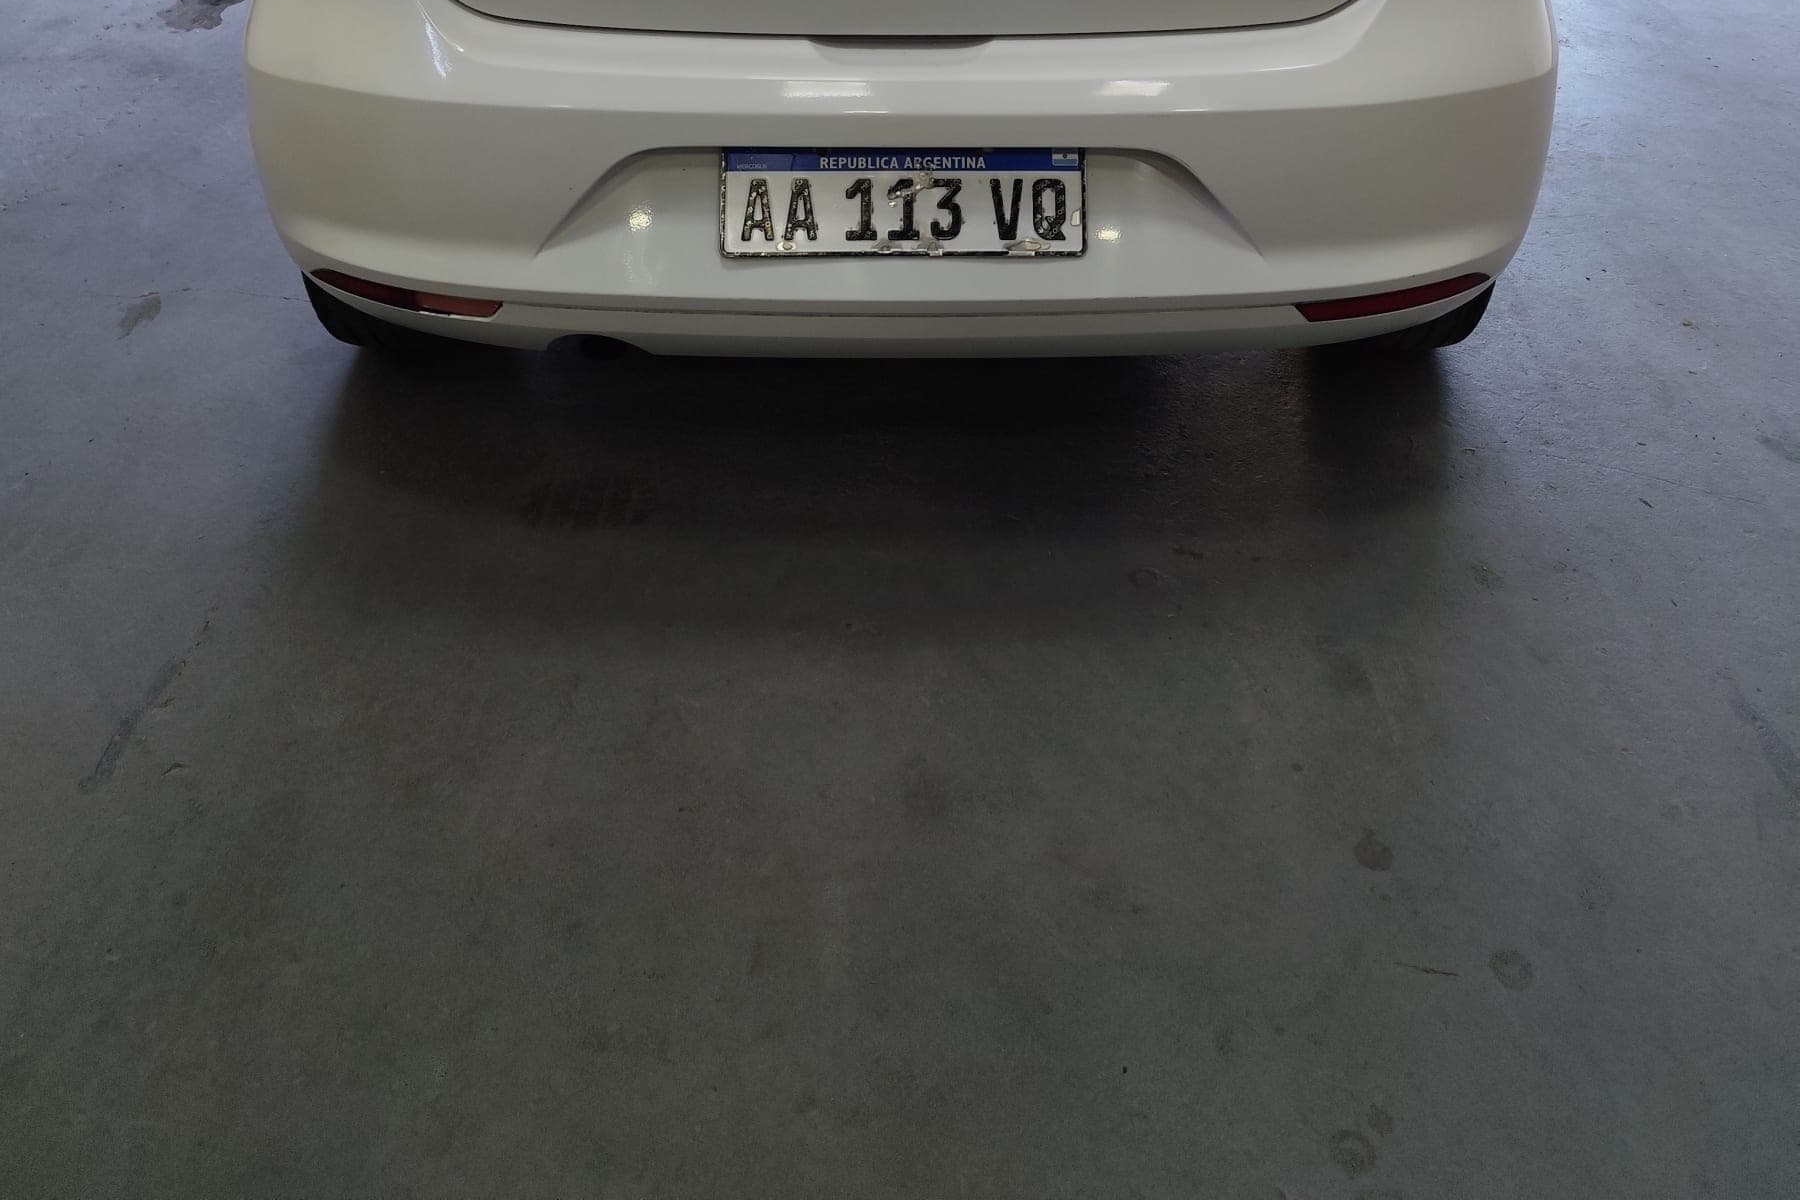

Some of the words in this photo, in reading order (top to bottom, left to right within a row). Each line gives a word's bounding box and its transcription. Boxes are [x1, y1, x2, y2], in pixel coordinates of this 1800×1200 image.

[820, 157, 899, 169] REPUBLICA
[903, 156, 986, 169] ARGENTINA
[741, 178, 818, 241] AA
[845, 178, 962, 241] 113
[989, 178, 1067, 241] VQ
